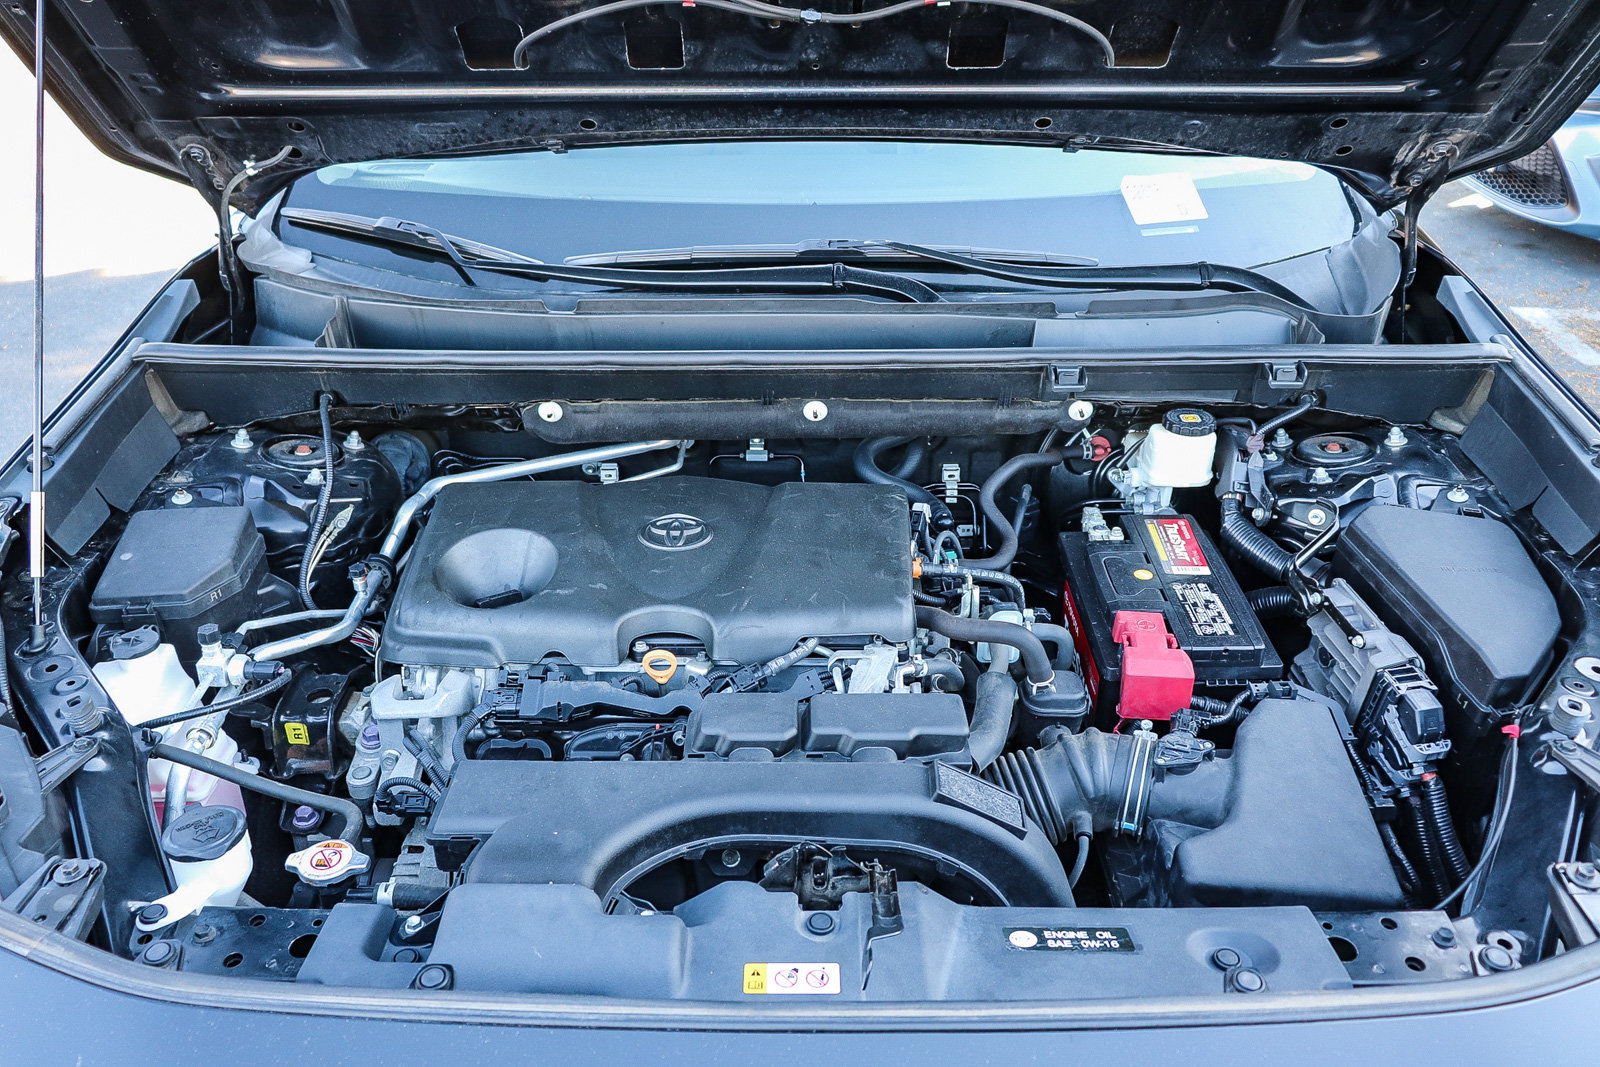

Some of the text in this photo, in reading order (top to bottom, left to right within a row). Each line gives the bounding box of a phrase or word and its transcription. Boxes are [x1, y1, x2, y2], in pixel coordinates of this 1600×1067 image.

[210, 588, 223, 602] R1
[1456, 692, 1469, 710] L1
[292, 728, 304, 740] R1
[193, 821, 210, 830] ONLY
[1043, 930, 1117, 939] ENGINE OIL
[1047, 940, 1120, 949] SAE 0W-16
